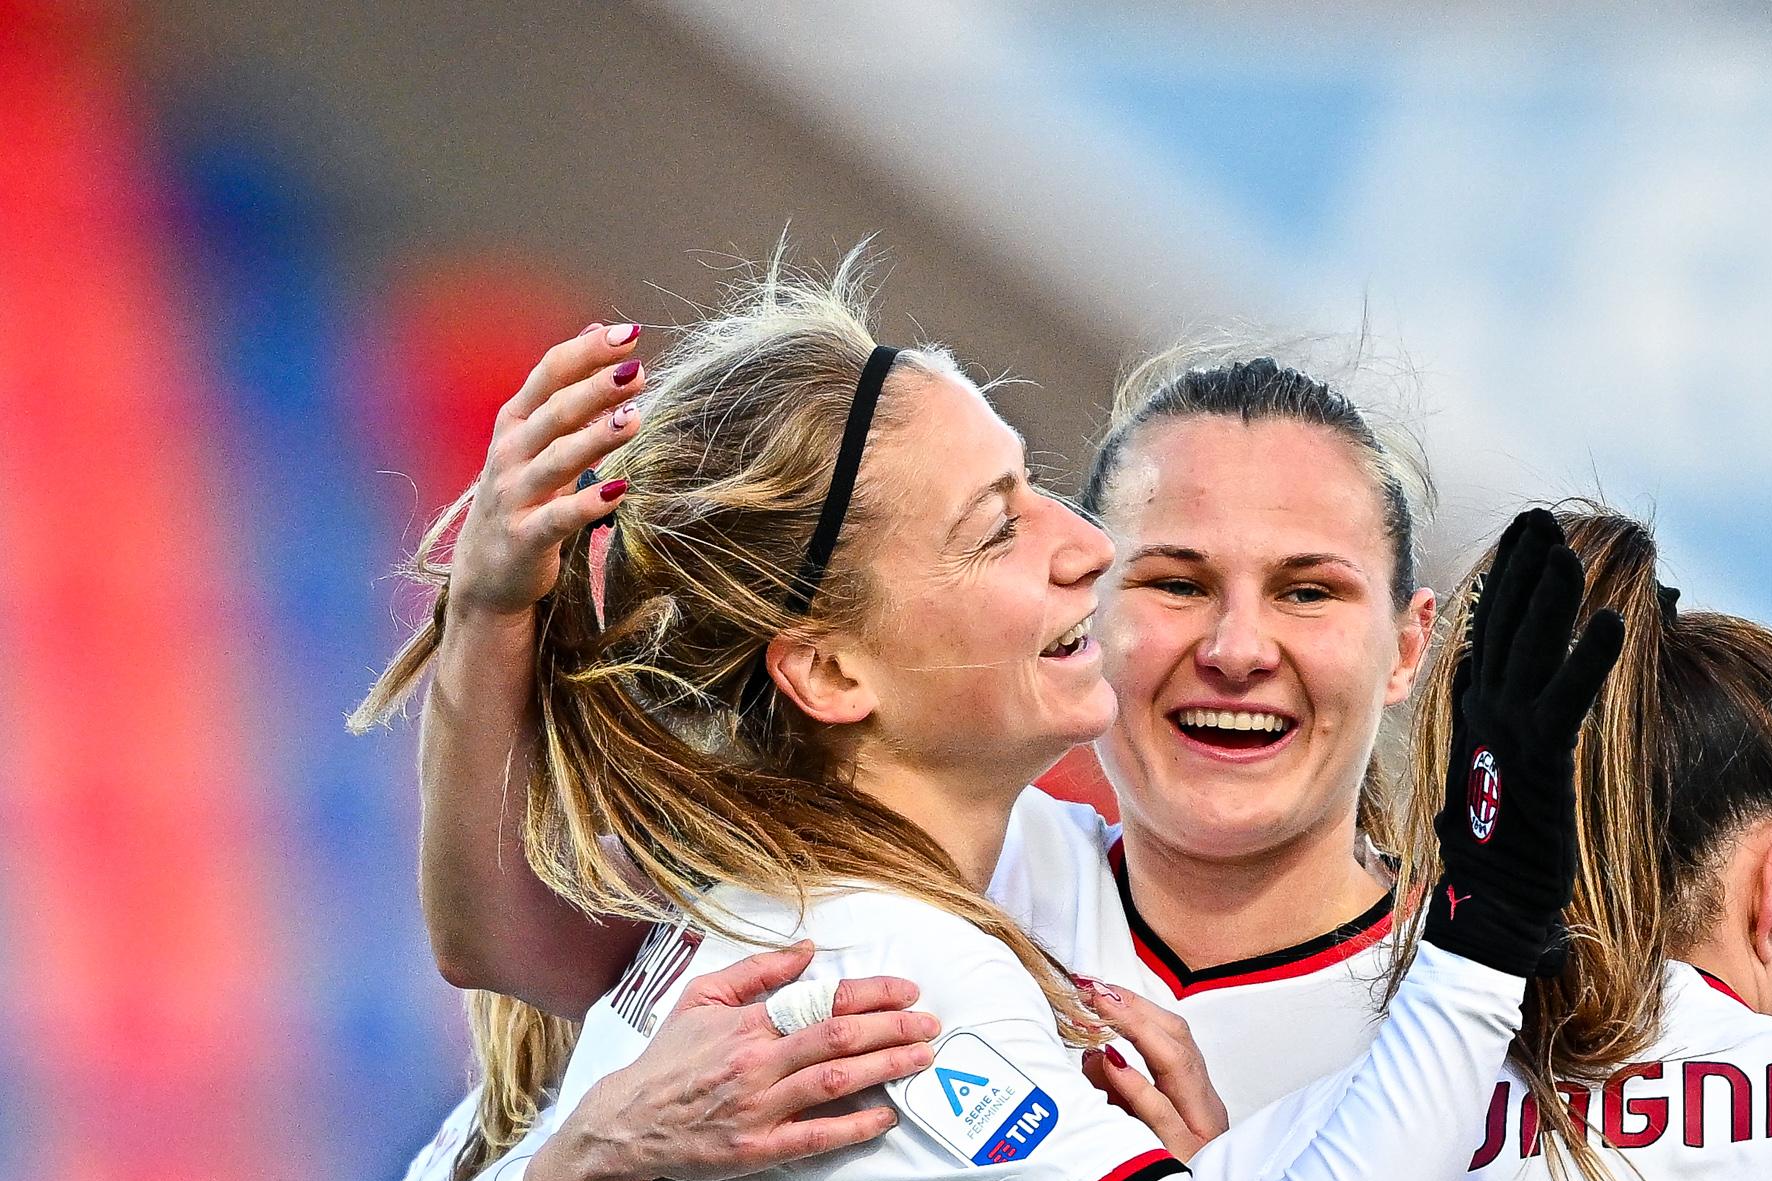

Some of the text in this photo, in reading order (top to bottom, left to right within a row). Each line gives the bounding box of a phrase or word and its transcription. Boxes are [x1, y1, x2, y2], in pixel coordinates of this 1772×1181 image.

[964, 1086, 1001, 1126] SERIE A
[966, 1085, 1016, 1140] FEMMINILE
[1005, 1102, 1050, 1144] TIM
